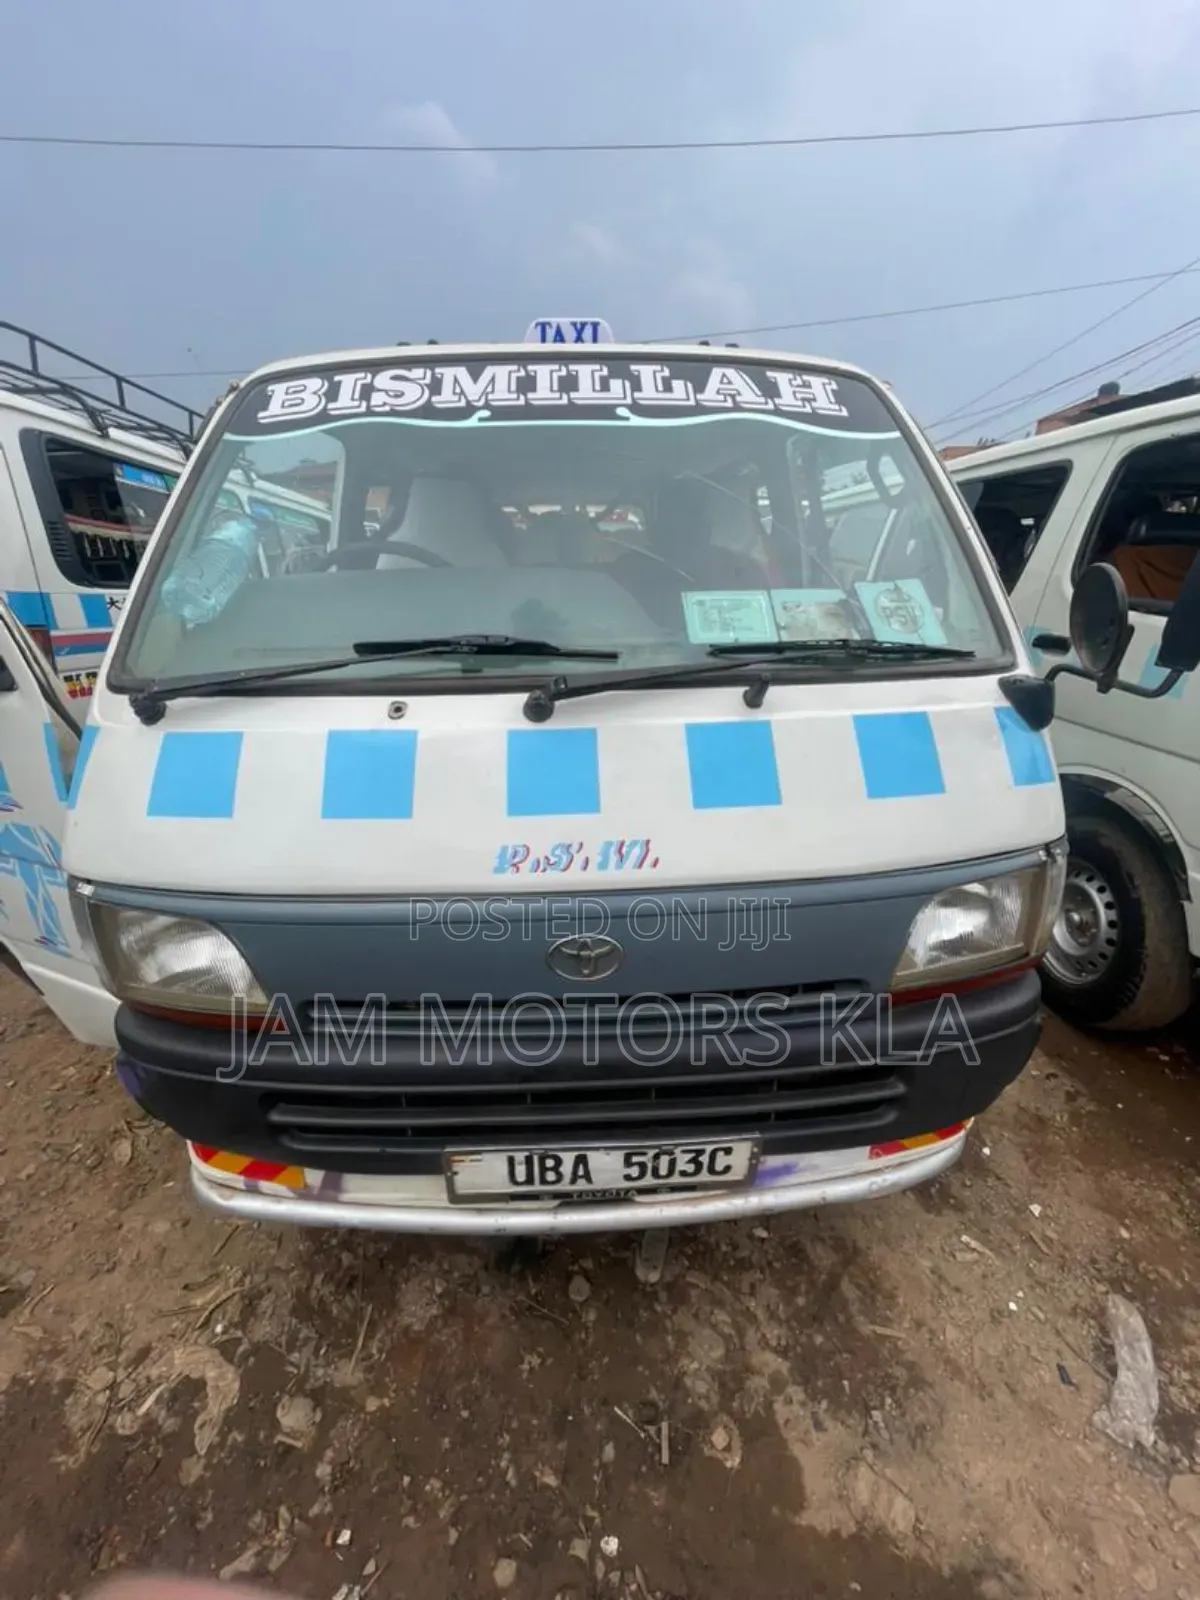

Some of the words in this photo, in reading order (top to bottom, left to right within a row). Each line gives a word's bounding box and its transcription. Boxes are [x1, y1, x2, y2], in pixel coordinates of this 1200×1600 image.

[535, 321, 600, 344] TAXI
[257, 363, 849, 422] BISMILLAH
[506, 1151, 594, 1187] UBA
[622, 1145, 734, 1183] 503C
[572, 1188, 639, 1200] TOYOTA
